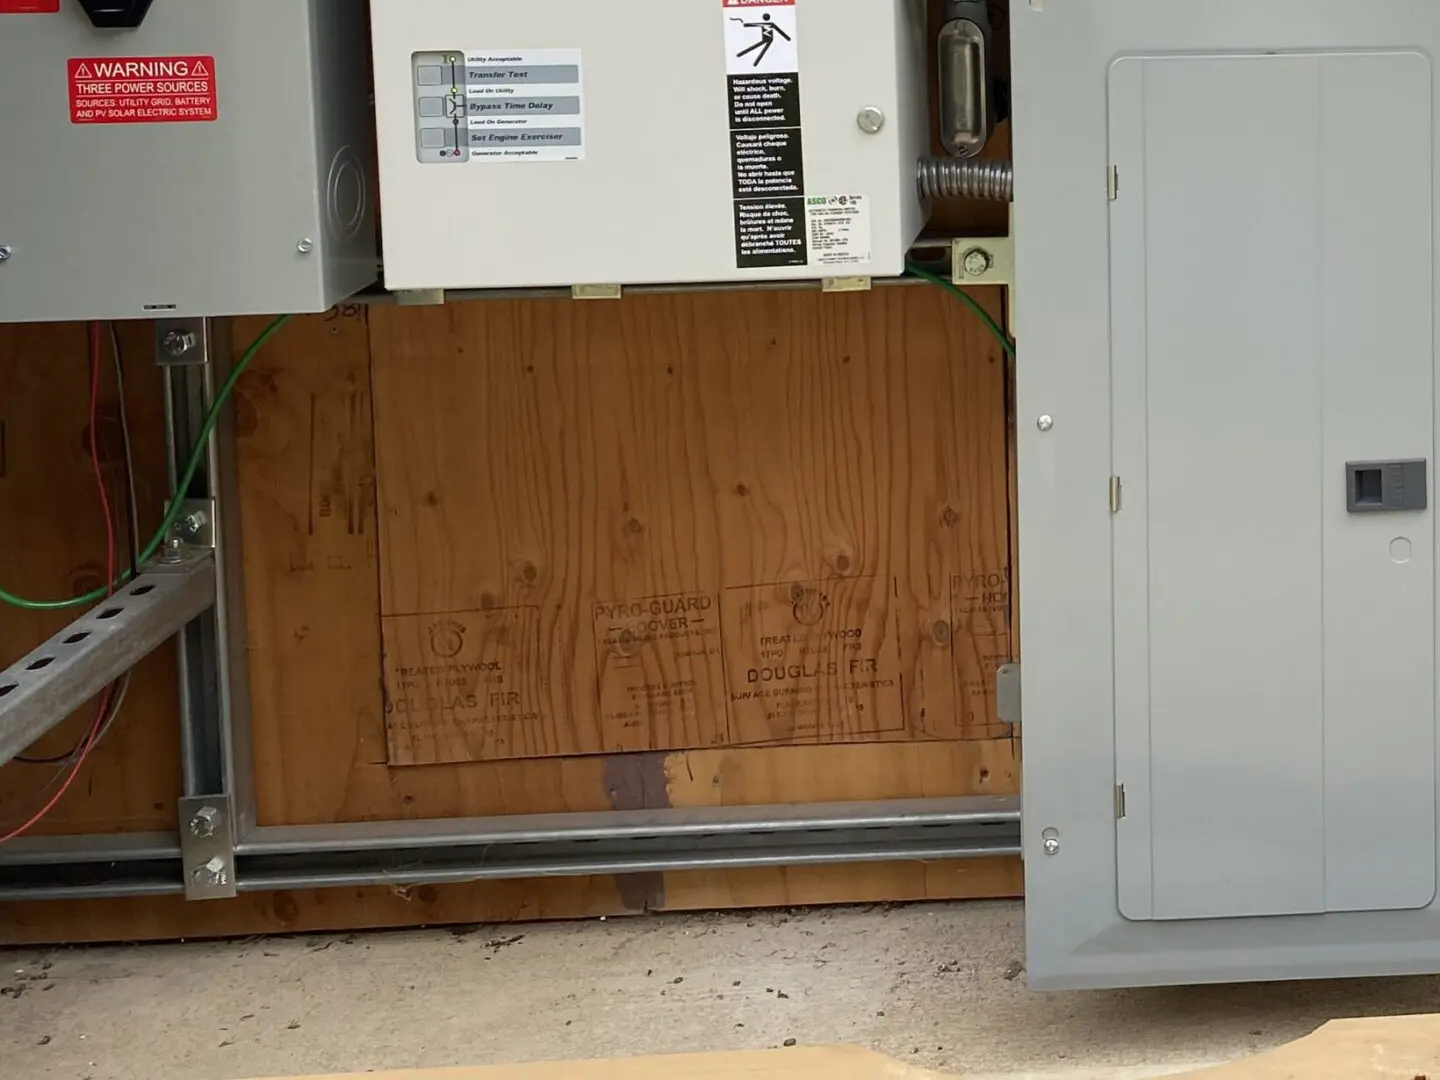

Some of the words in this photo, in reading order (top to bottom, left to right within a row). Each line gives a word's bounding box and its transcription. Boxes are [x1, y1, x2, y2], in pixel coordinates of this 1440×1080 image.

[94, 62, 188, 77] WARNING
[77, 84, 112, 94] THREE
[115, 83, 154, 93] POWER
[156, 82, 208, 92] SOURCES
[120, 98, 148, 106] UTILITY
[175, 97, 210, 106] BATTERY
[76, 110, 93, 118] AND
[108, 109, 135, 117] SOLAR
[138, 108, 176, 116] ELECTRIC
[178, 108, 211, 116] SYSTEM
[595, 596, 711, 620] PYRO-GUARD
[748, 662, 837, 683] DOUGLAS
[850, 658, 877, 674] FIR
